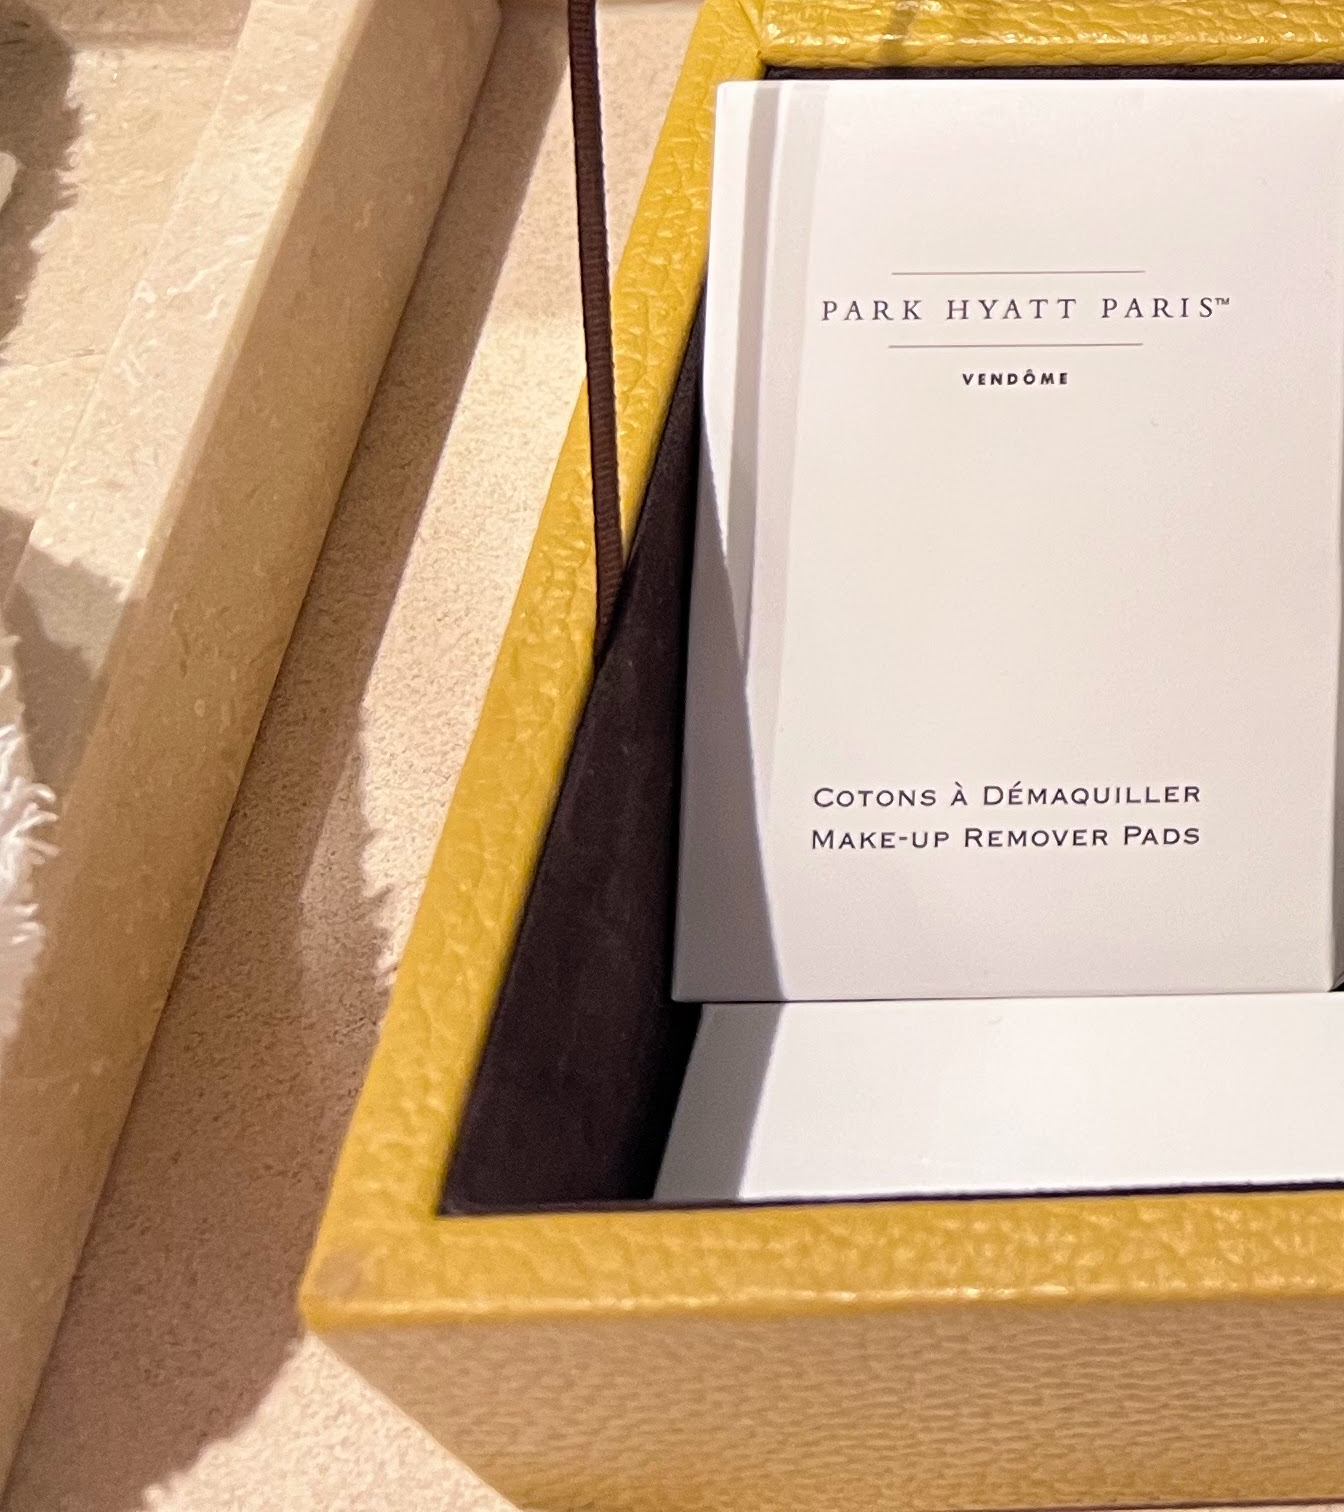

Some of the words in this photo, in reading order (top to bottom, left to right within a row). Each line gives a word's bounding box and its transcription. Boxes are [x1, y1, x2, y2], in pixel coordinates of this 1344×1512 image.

[821, 299, 922, 322] PARK
[946, 298, 1077, 321] HYATT
[961, 368, 1068, 386] VENDÔME
